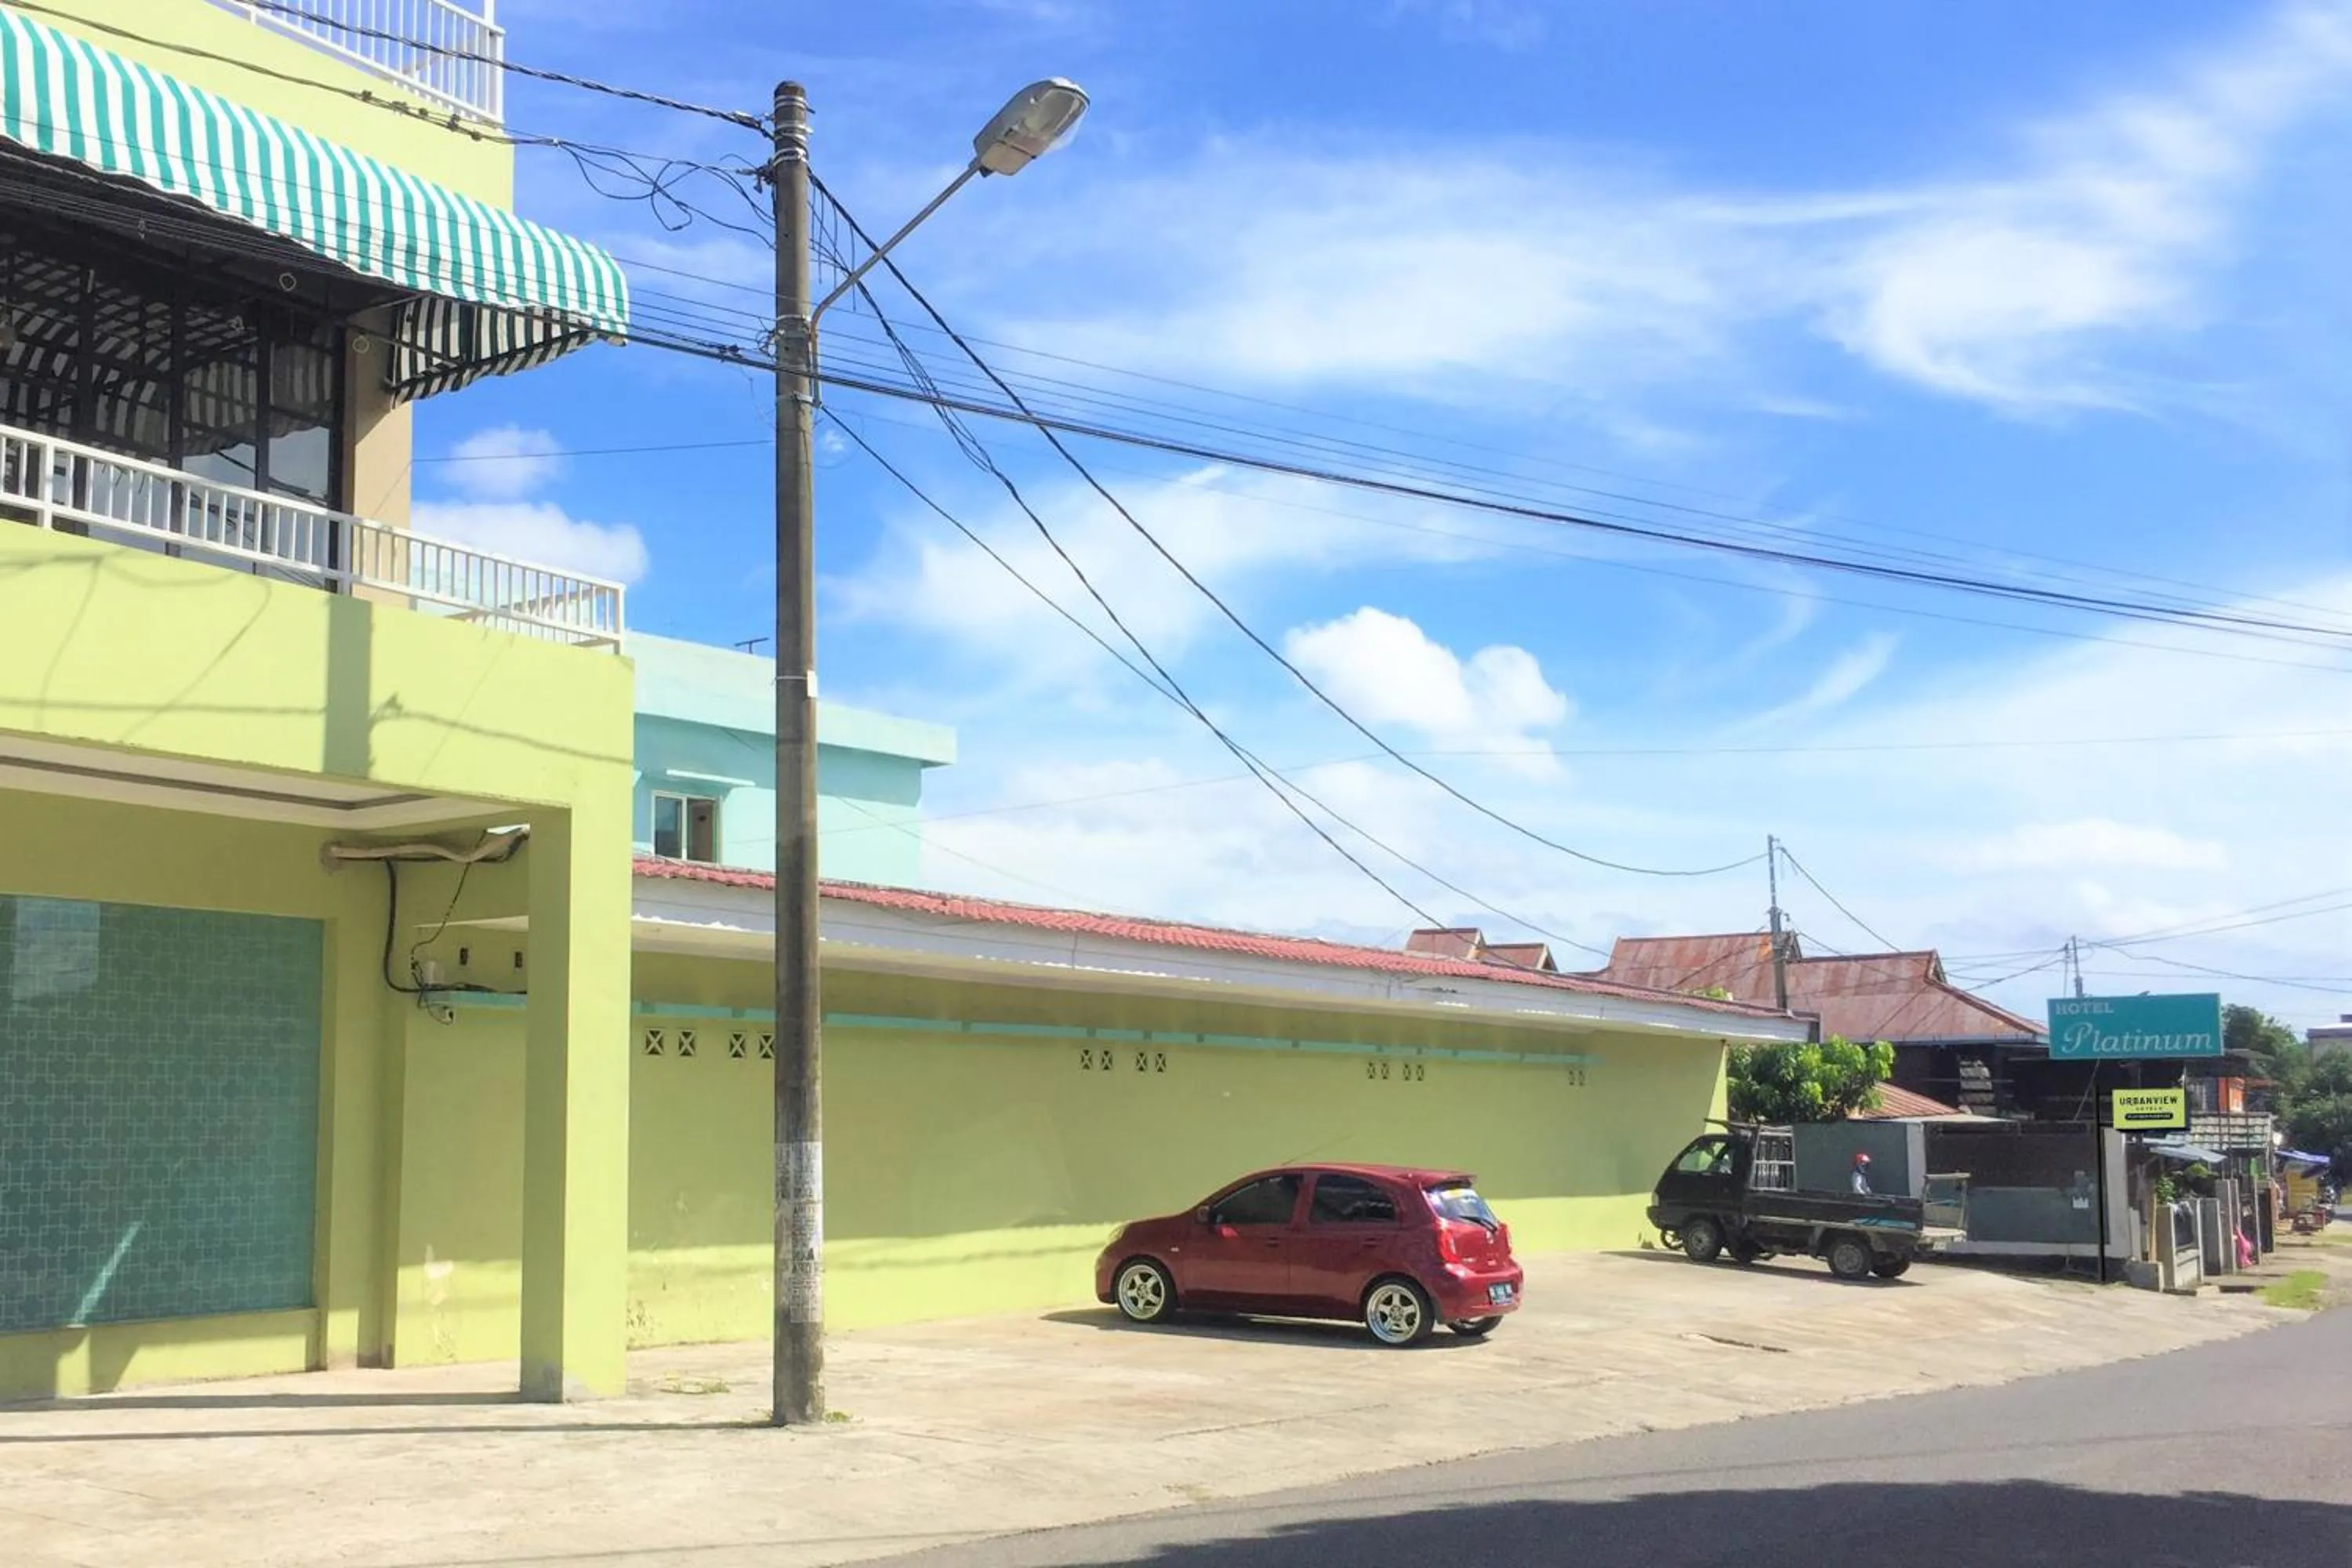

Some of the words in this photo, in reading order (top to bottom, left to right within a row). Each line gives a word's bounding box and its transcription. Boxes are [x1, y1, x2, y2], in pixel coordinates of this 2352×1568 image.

[2056, 1001, 2114, 1015] HOTEL
[2061, 1022, 2213, 1054] Platinum
[2119, 1096, 2178, 1105] URBANVIEW
